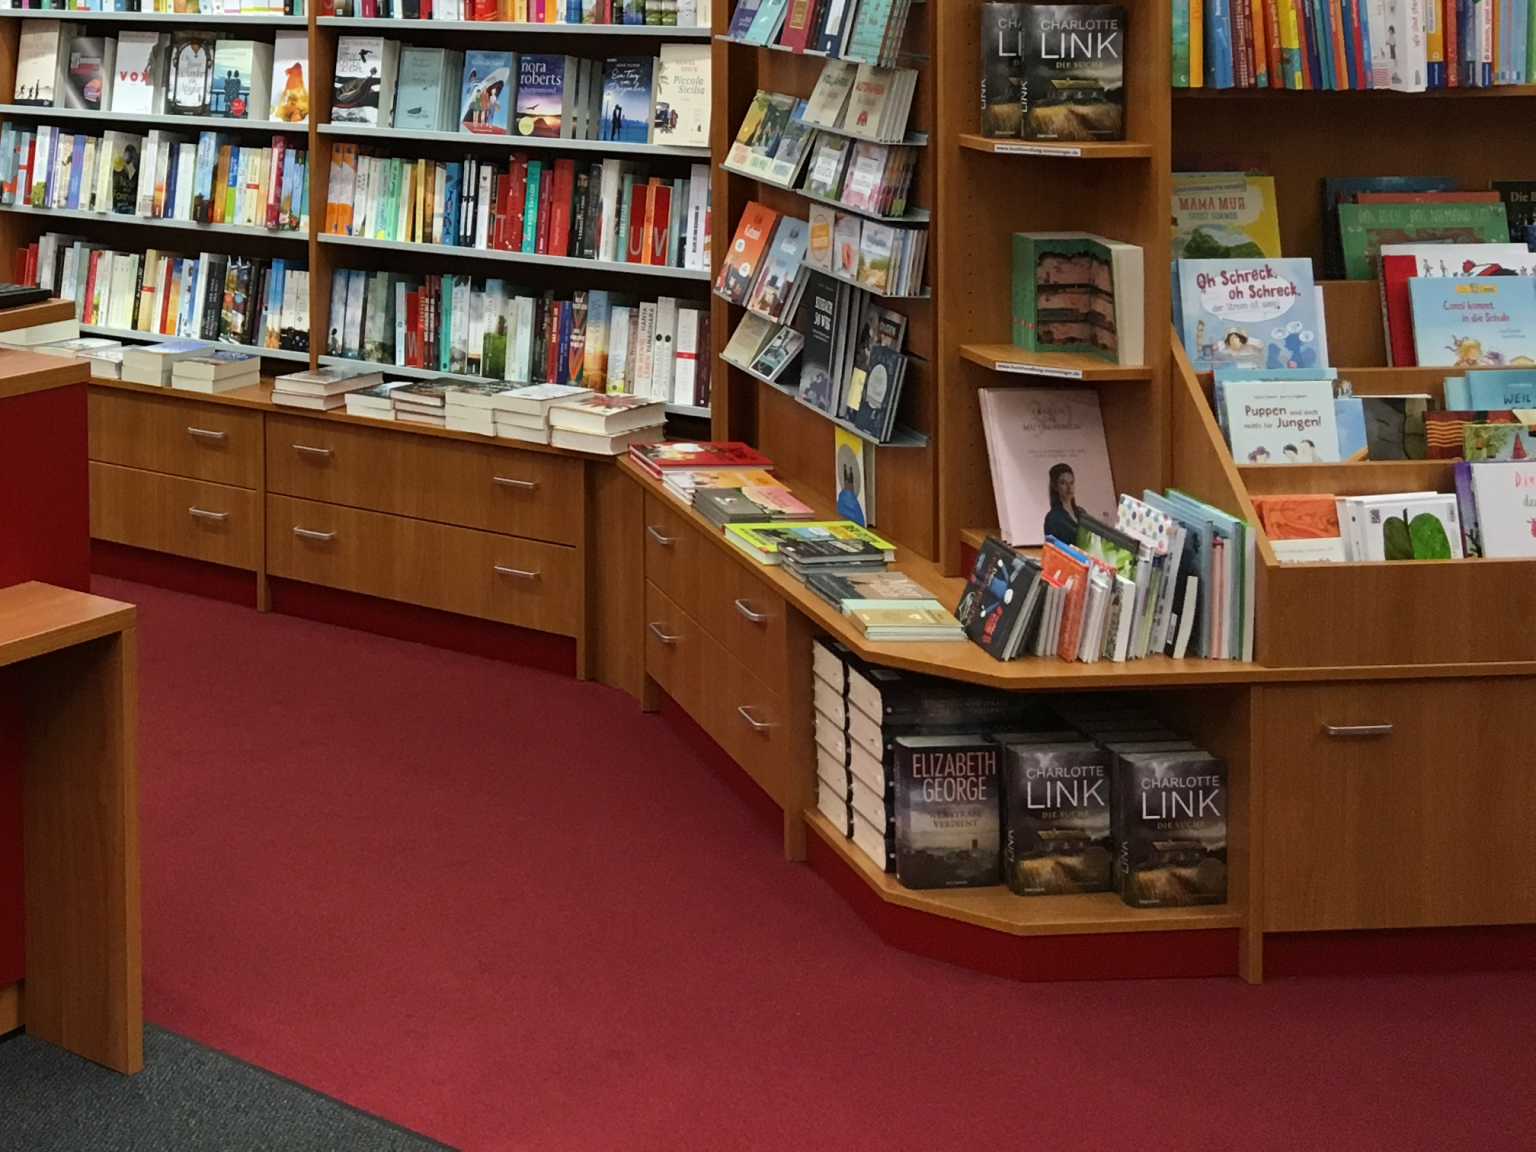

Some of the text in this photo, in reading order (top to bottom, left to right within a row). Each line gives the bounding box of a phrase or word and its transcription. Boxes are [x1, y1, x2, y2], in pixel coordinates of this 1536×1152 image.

[1040, 19, 1118, 30] CHARLOTTE
[1041, 32, 1118, 58] LINK
[521, 61, 547, 74] nora
[1056, 61, 1070, 69] DIE
[120, 71, 149, 83] VOX
[520, 73, 562, 86] roberts
[673, 76, 704, 86] Piccola
[678, 84, 705, 95] Sicilia
[1179, 196, 1214, 210] MAMA
[1510, 192, 1528, 202] Die
[629, 226, 644, 256] U
[653, 226, 668, 257] V
[1196, 272, 1217, 290] Oh
[1228, 284, 1244, 299] oh
[1227, 301, 1249, 311] Strom
[1443, 299, 1495, 311] Conni kommt
[1462, 312, 1511, 323] in die Schule
[646, 307, 654, 353] YANAGIHARA
[1504, 394, 1532, 406] WEIL
[1245, 405, 1287, 418] Puppen
[1277, 416, 1322, 431] Jungen!
[913, 751, 996, 778] ELIZABETH
[1026, 765, 1104, 779] CHARLOTTE
[1141, 775, 1220, 789] CHARLOTTE
[923, 777, 986, 803] GEORGE
[1027, 779, 1105, 809] LINK
[1142, 789, 1221, 820] LINK
[934, 819, 977, 829] VERDIENT
[1157, 822, 1172, 830] DIE
